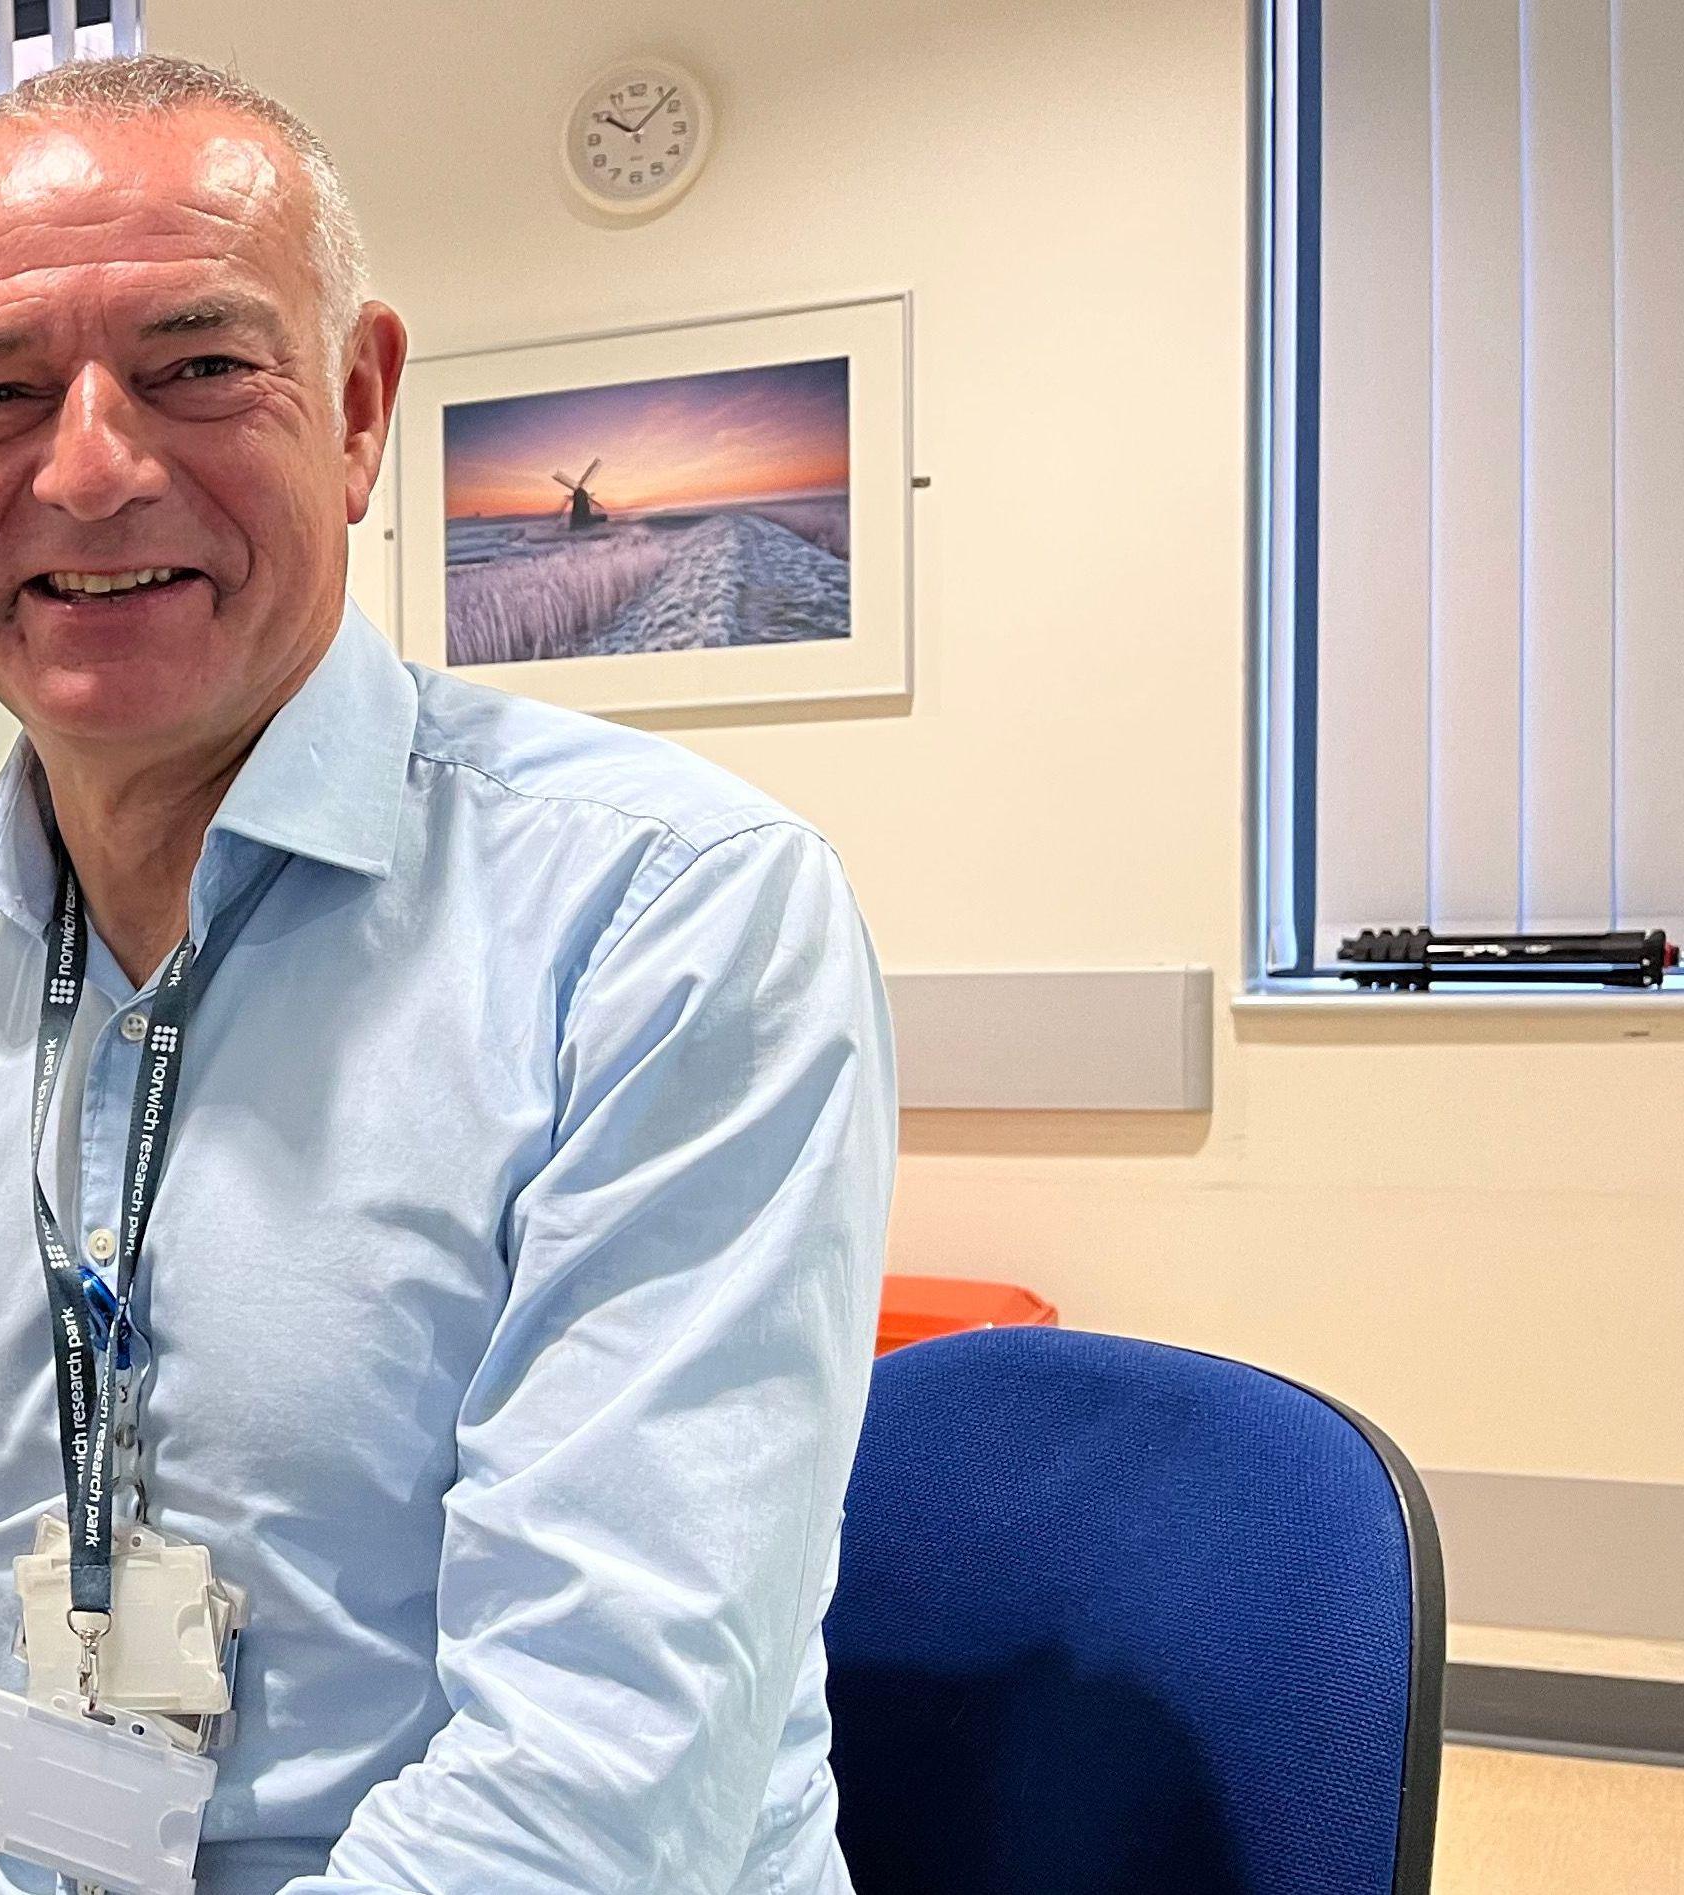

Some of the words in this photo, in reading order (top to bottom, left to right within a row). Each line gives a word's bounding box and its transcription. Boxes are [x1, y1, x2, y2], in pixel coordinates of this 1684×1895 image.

[667, 99, 682, 113] 2
[587, 133, 601, 146] 9
[672, 121, 687, 135] 3
[593, 153, 607, 168] 8
[650, 162, 665, 175] 5
[666, 144, 680, 155] 4
[608, 167, 622, 180] 7
[629, 171, 643, 184] 6
[58, 914, 76, 976] norwich
[44, 1037, 58, 1076] park
[143, 1056, 168, 1131] norwich
[131, 1135, 154, 1212] research
[125, 1215, 139, 1256] park
[61, 1306, 83, 1348] park
[67, 1351, 86, 1429] research
[89, 1423, 107, 1502] research
[84, 1503, 99, 1549] park
